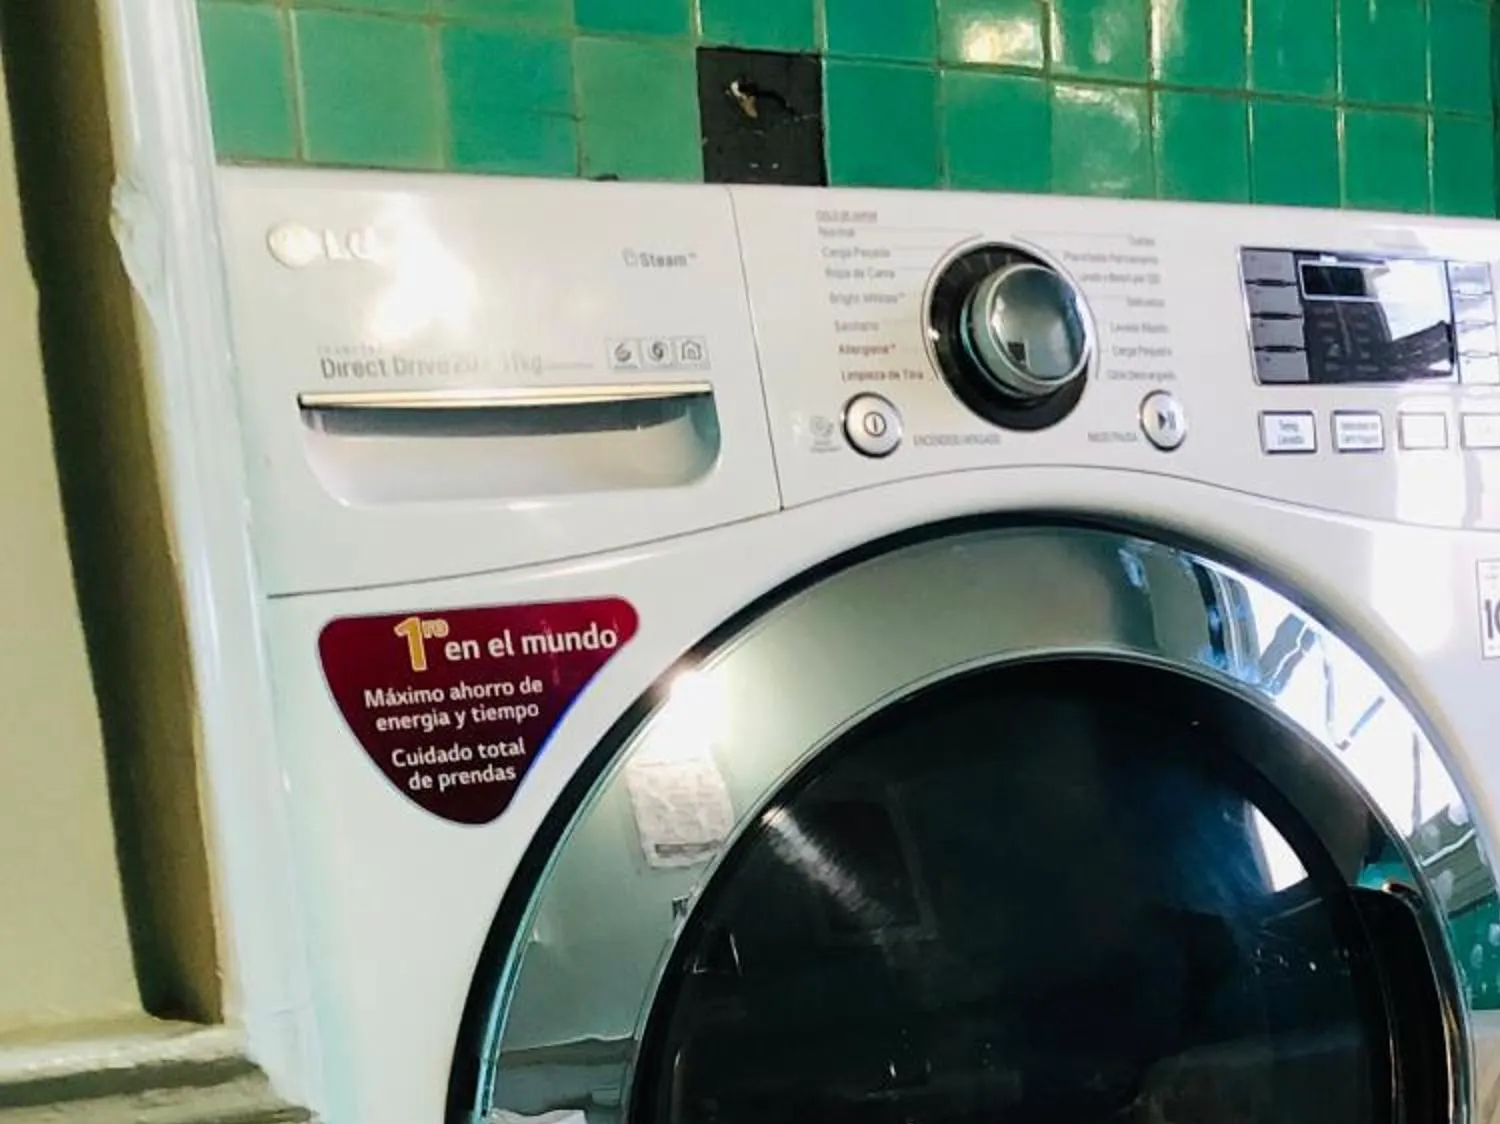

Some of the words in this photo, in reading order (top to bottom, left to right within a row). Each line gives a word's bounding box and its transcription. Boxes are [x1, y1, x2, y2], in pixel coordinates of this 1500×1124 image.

[319, 356, 389, 380] Direct
[444, 639, 481, 662] en
[487, 628, 515, 658] el
[520, 621, 618, 656] mundo
[363, 685, 445, 709] Máximo
[449, 680, 515, 701] ahorro
[519, 675, 543, 694] de
[454, 709, 467, 730] y
[471, 702, 540, 725] tiempo
[391, 741, 474, 768] Cuidado
[477, 735, 527, 757] total
[408, 771, 433, 791] de
[437, 763, 517, 793] prendas
